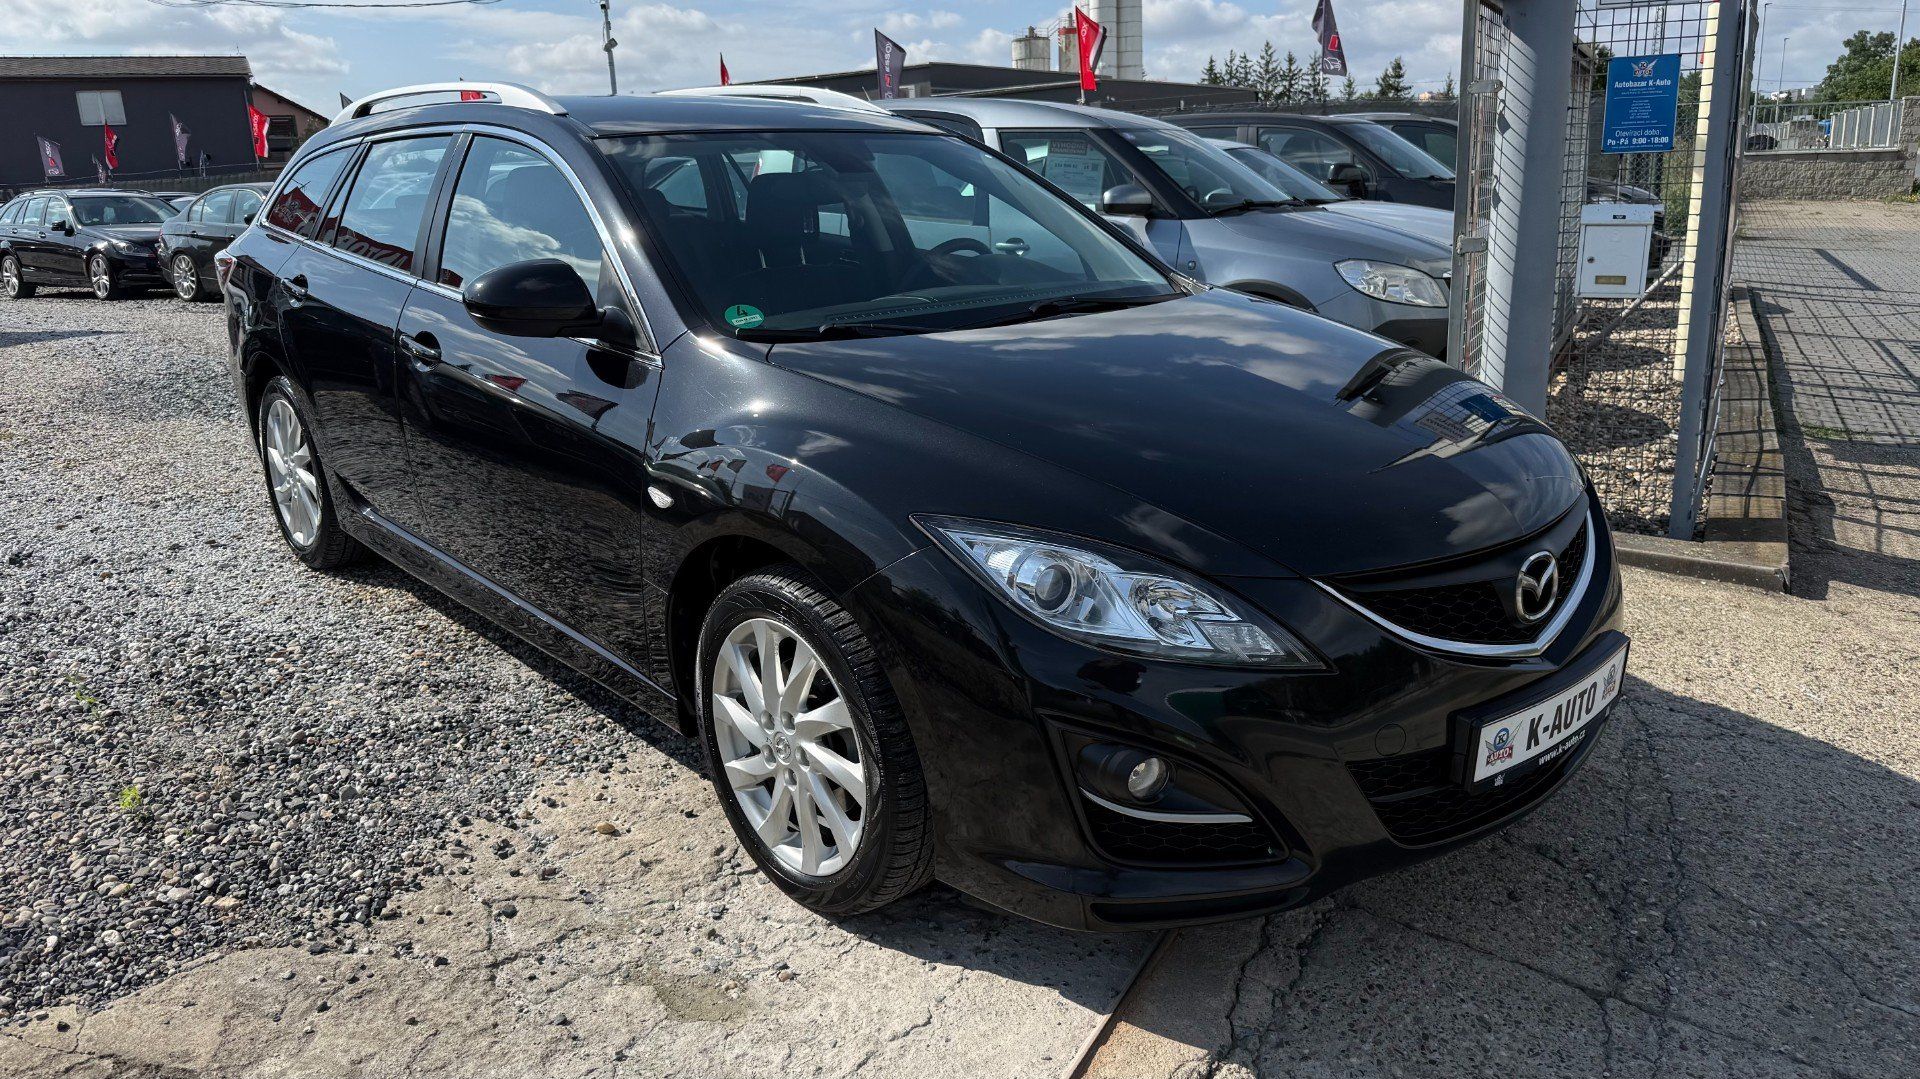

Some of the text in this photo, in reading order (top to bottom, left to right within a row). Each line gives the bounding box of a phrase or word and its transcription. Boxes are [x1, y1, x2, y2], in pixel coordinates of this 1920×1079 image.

[1614, 78, 1671, 88] Autobazar K-Auto
[1643, 128, 1662, 136] doba:
[1525, 681, 1598, 751] K-AUTO
[1488, 747, 1510, 763] AUTO
[1538, 729, 1586, 766] www.k-auto.cz
